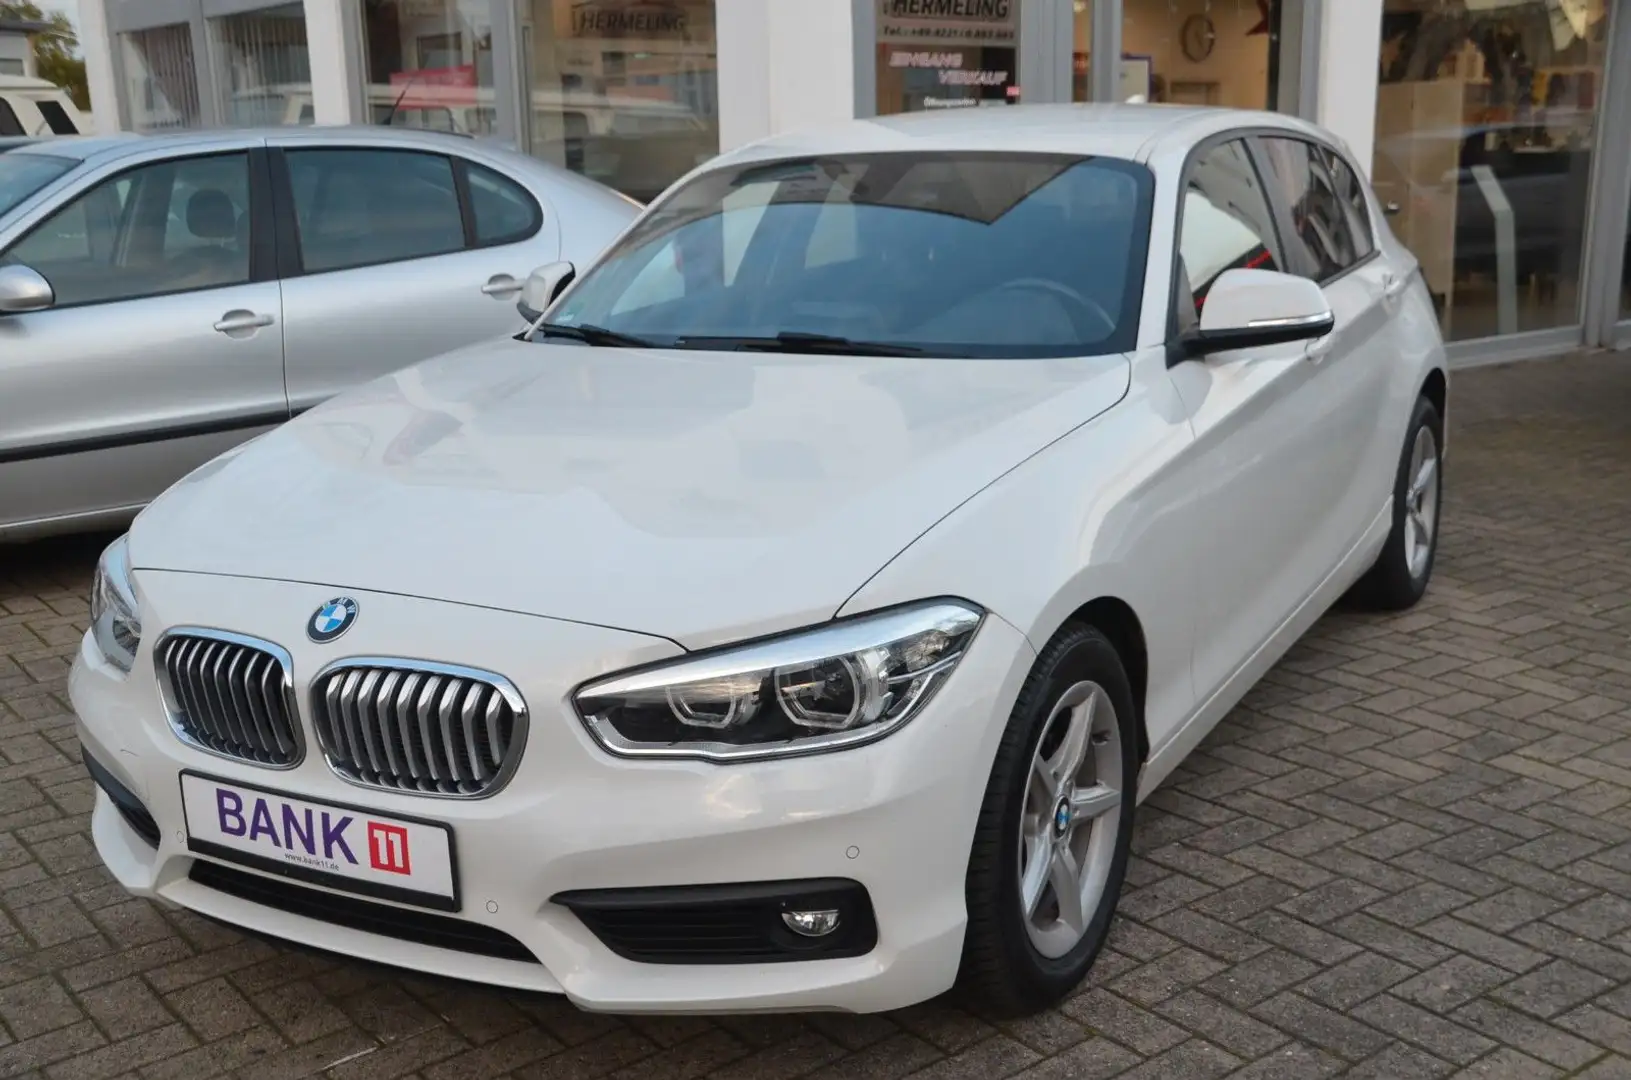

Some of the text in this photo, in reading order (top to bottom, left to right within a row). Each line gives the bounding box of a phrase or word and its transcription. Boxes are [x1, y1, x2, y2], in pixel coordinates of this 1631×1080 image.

[892, 0, 1008, 18] HERMELING
[581, 10, 686, 32] HERMELING
[938, 70, 1008, 85] VERKAUF
[215, 787, 406, 870] BANK 11
[284, 852, 340, 871] www.bank11.de
